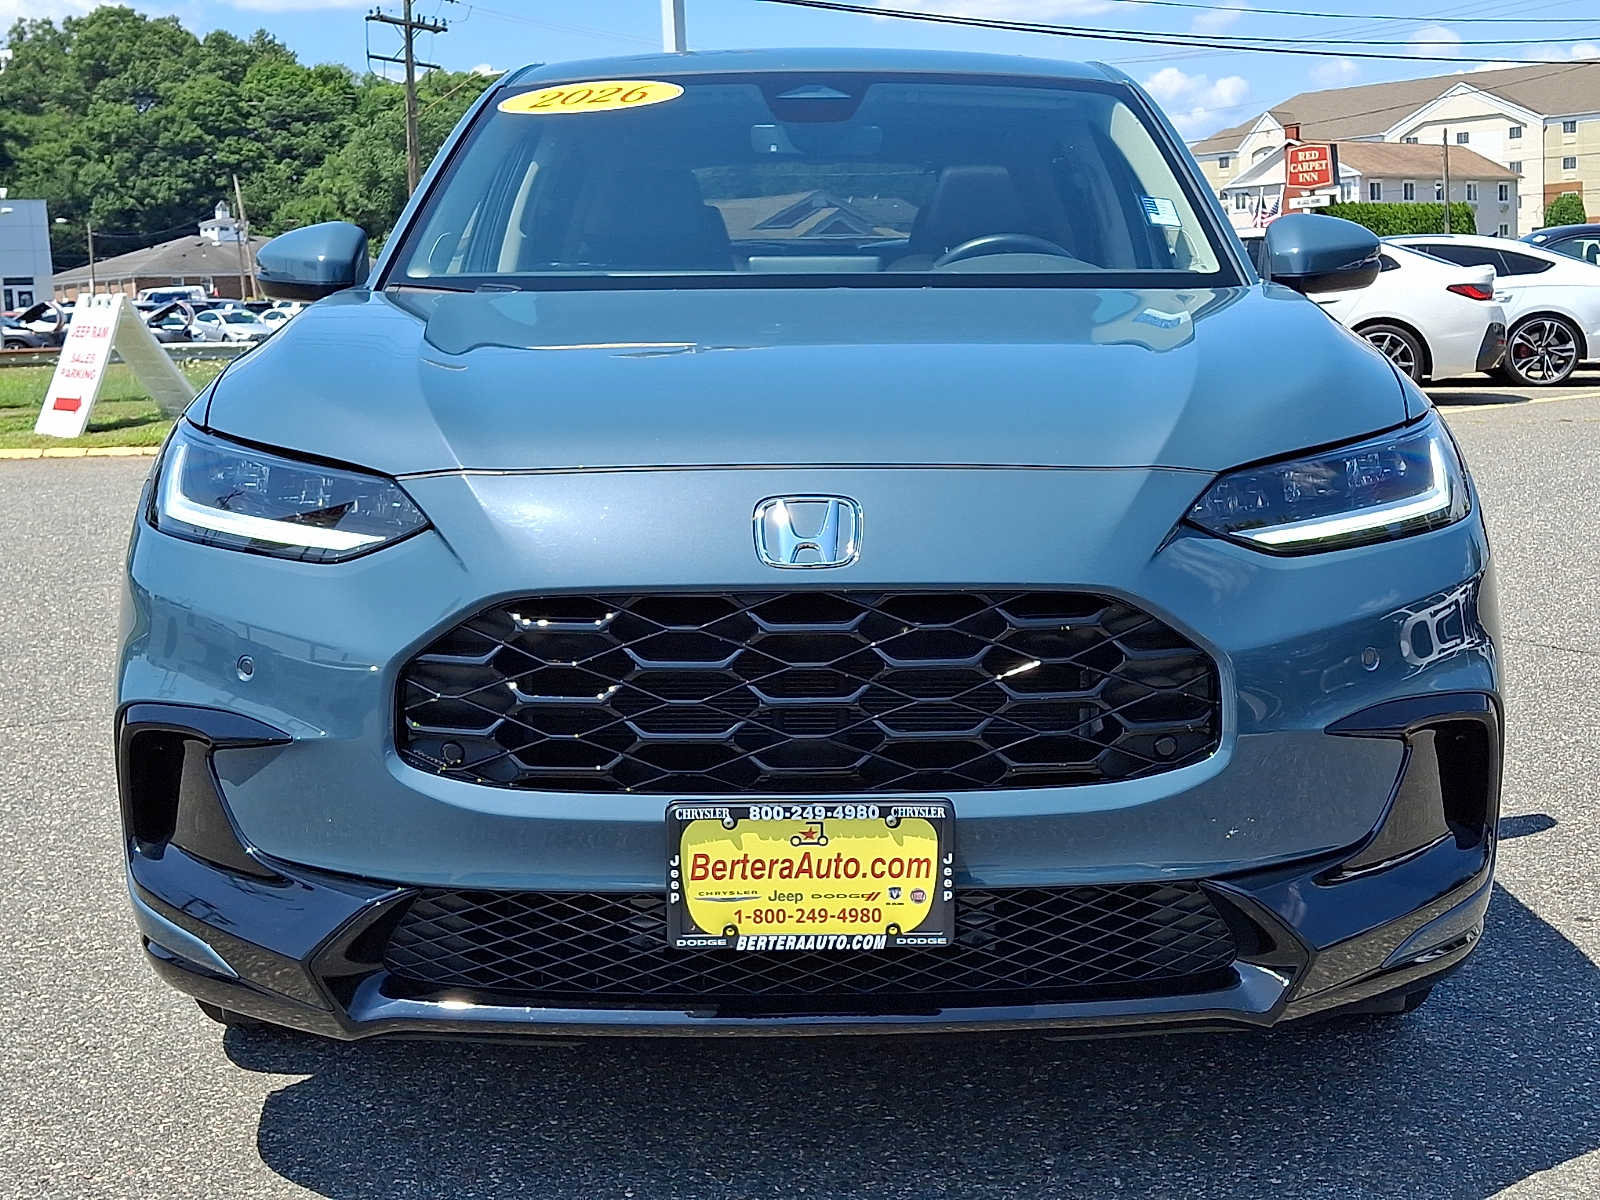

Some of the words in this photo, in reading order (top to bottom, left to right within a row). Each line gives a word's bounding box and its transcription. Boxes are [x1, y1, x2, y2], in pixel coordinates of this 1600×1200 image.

[529, 84, 657, 109] 2026
[1298, 151, 1319, 161] RED
[1290, 160, 1328, 173] CARPET
[1298, 172, 1319, 182] INN
[60, 368, 97, 380] PARKING
[675, 807, 730, 820] CHRYSLER
[749, 806, 880, 820] 800-249-4980
[890, 806, 946, 819] CHRYSLER
[690, 852, 932, 881] BerteraAuto.com
[669, 854, 680, 904] Jeep
[942, 853, 953, 902] Jeep
[768, 890, 804, 904] Jeep
[733, 907, 882, 925] 1-800-249-4980
[676, 939, 727, 947] DODGE
[735, 934, 887, 951] BERTERAAUTO.COM
[896, 937, 948, 945] DODGE
